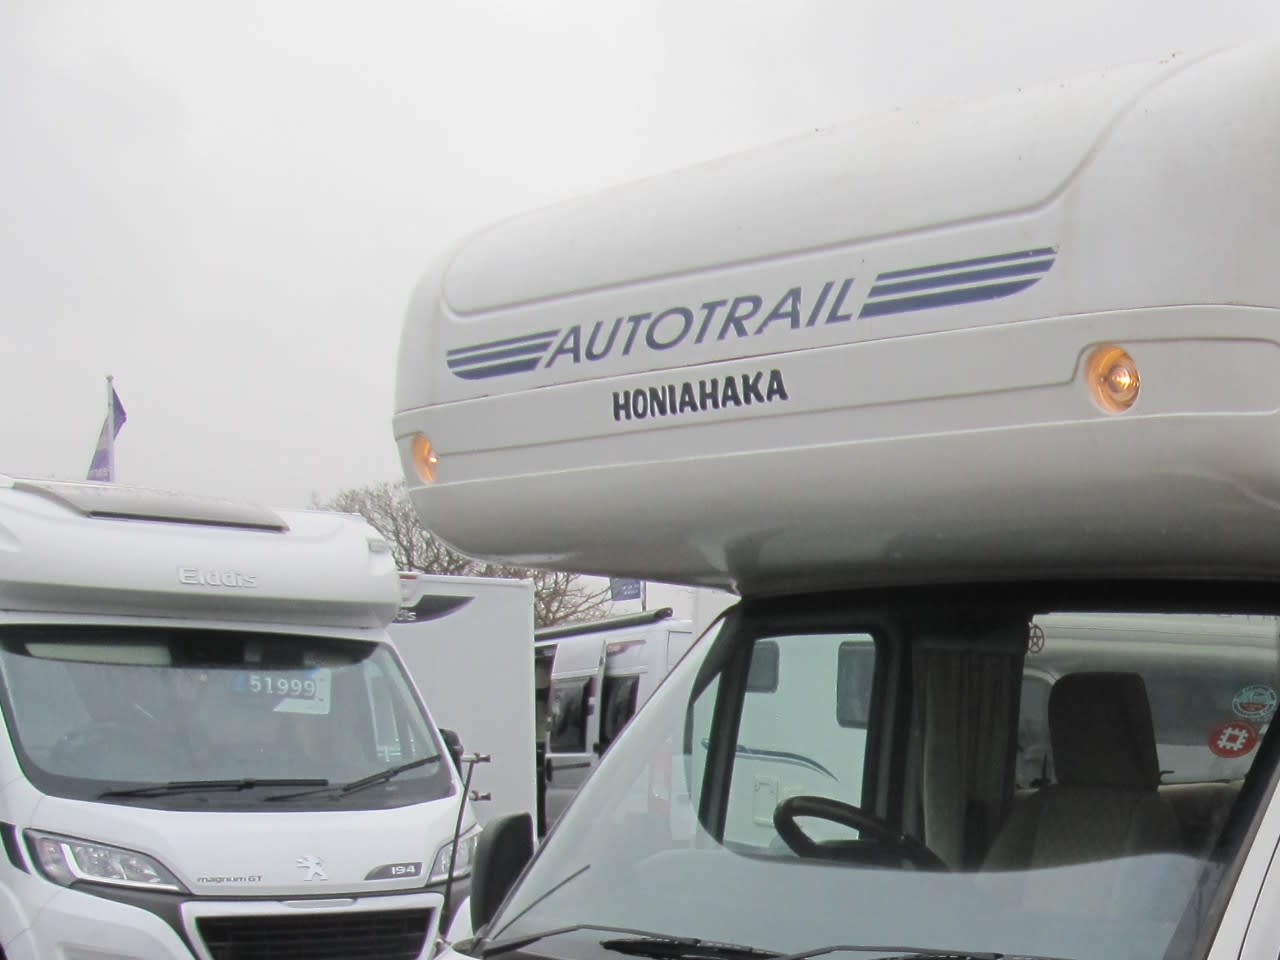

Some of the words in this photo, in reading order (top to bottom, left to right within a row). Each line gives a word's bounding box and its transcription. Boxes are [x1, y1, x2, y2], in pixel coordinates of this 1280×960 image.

[544, 278, 855, 369] AUTOTRAIL
[612, 368, 788, 421] HONIAHAKA
[249, 674, 315, 697] 51999
[391, 865, 416, 875] 194
